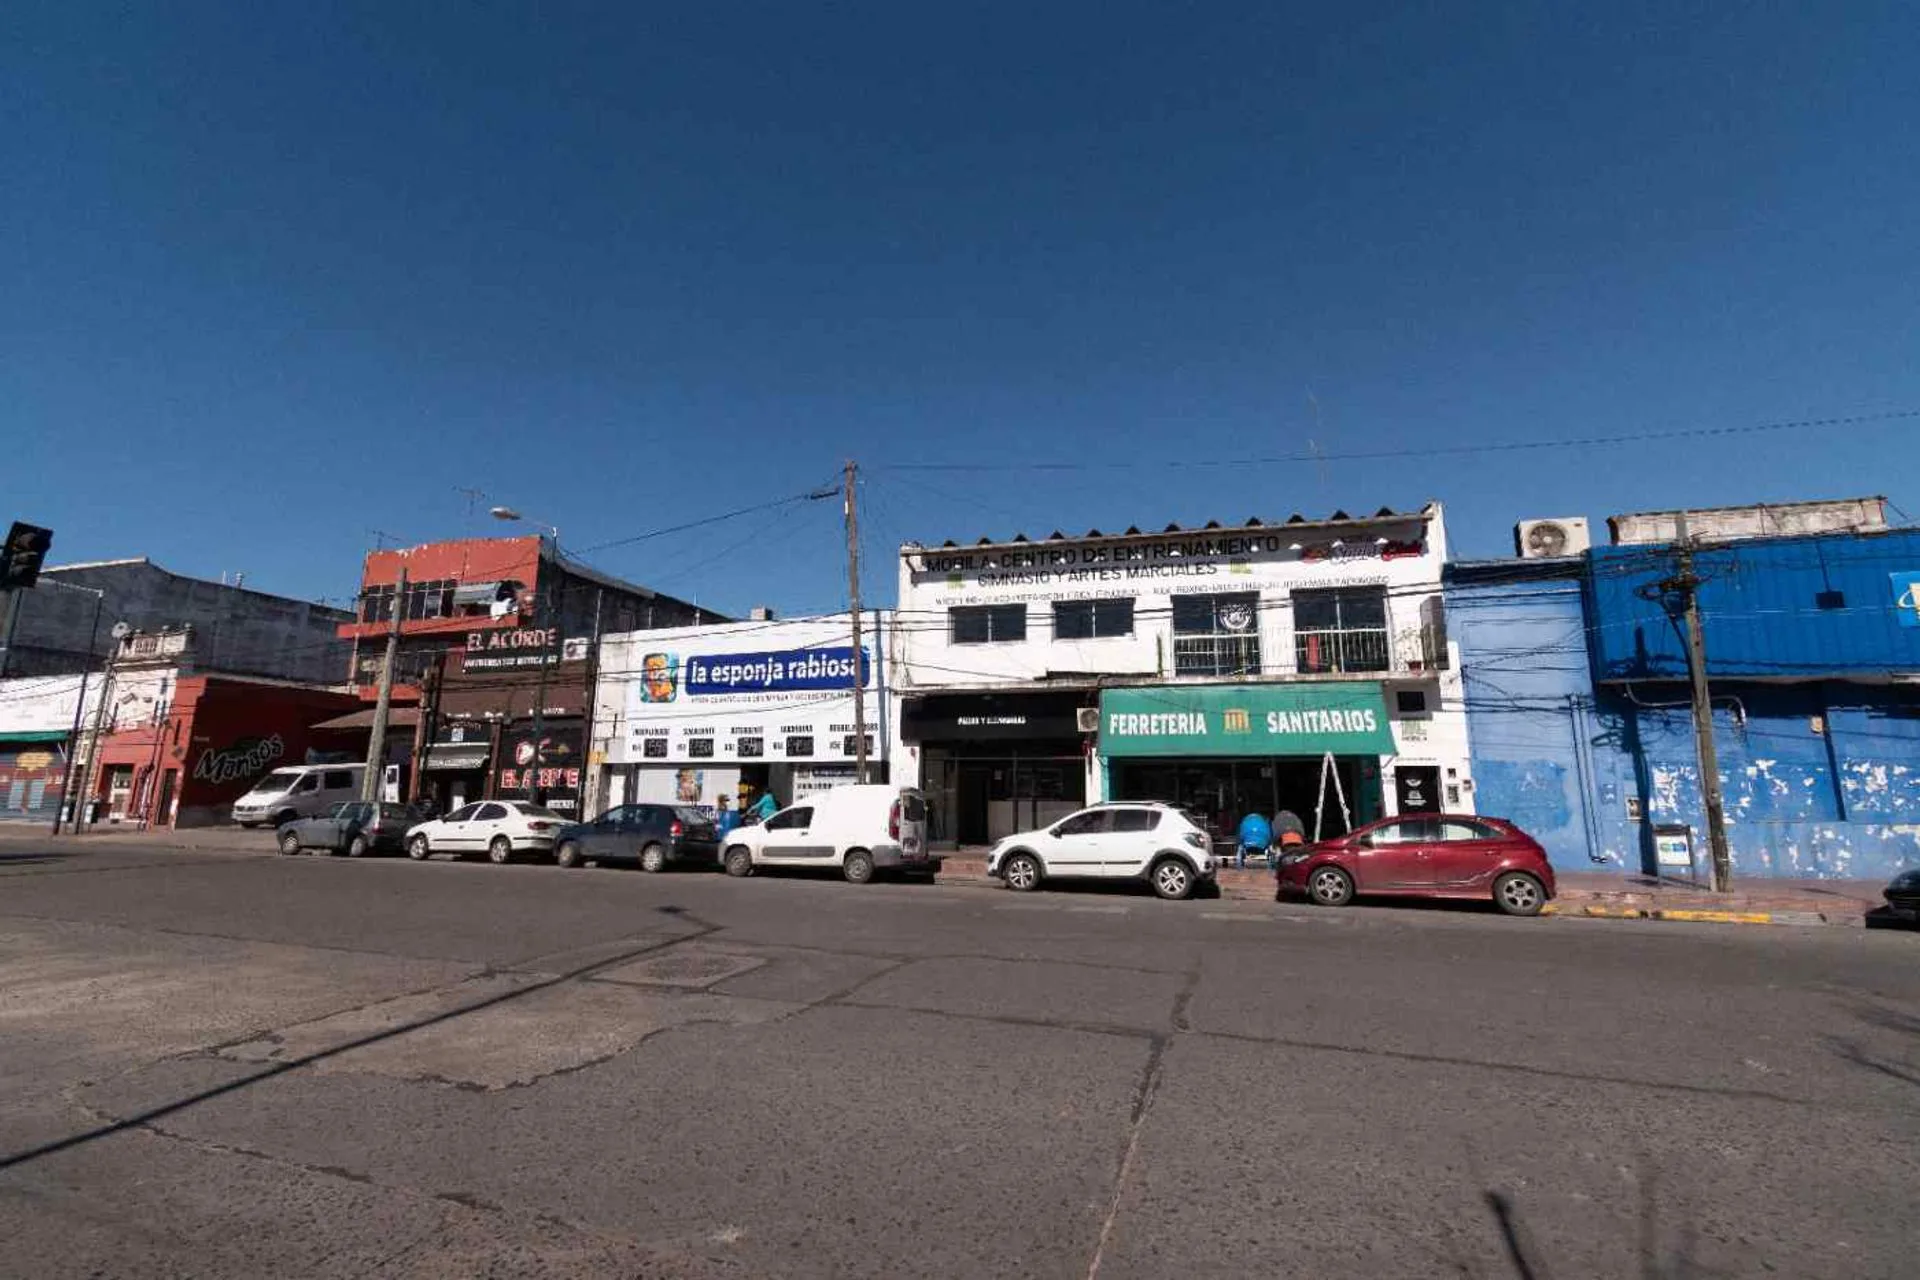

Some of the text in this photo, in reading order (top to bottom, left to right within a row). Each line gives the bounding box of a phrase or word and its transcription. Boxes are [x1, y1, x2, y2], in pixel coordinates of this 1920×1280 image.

[1082, 545, 1108, 566] DE
[1113, 536, 1279, 561] ENTRENAMIENTO
[977, 571, 1050, 588] GIMNASIO
[1068, 566, 1122, 583] ARTES
[1126, 561, 1218, 580] MARCIALES
[466, 633, 484, 652] EL
[691, 660, 707, 683] la
[711, 656, 783, 686] esponja
[1109, 709, 1377, 735] FERRETERIA SANITARIOS
